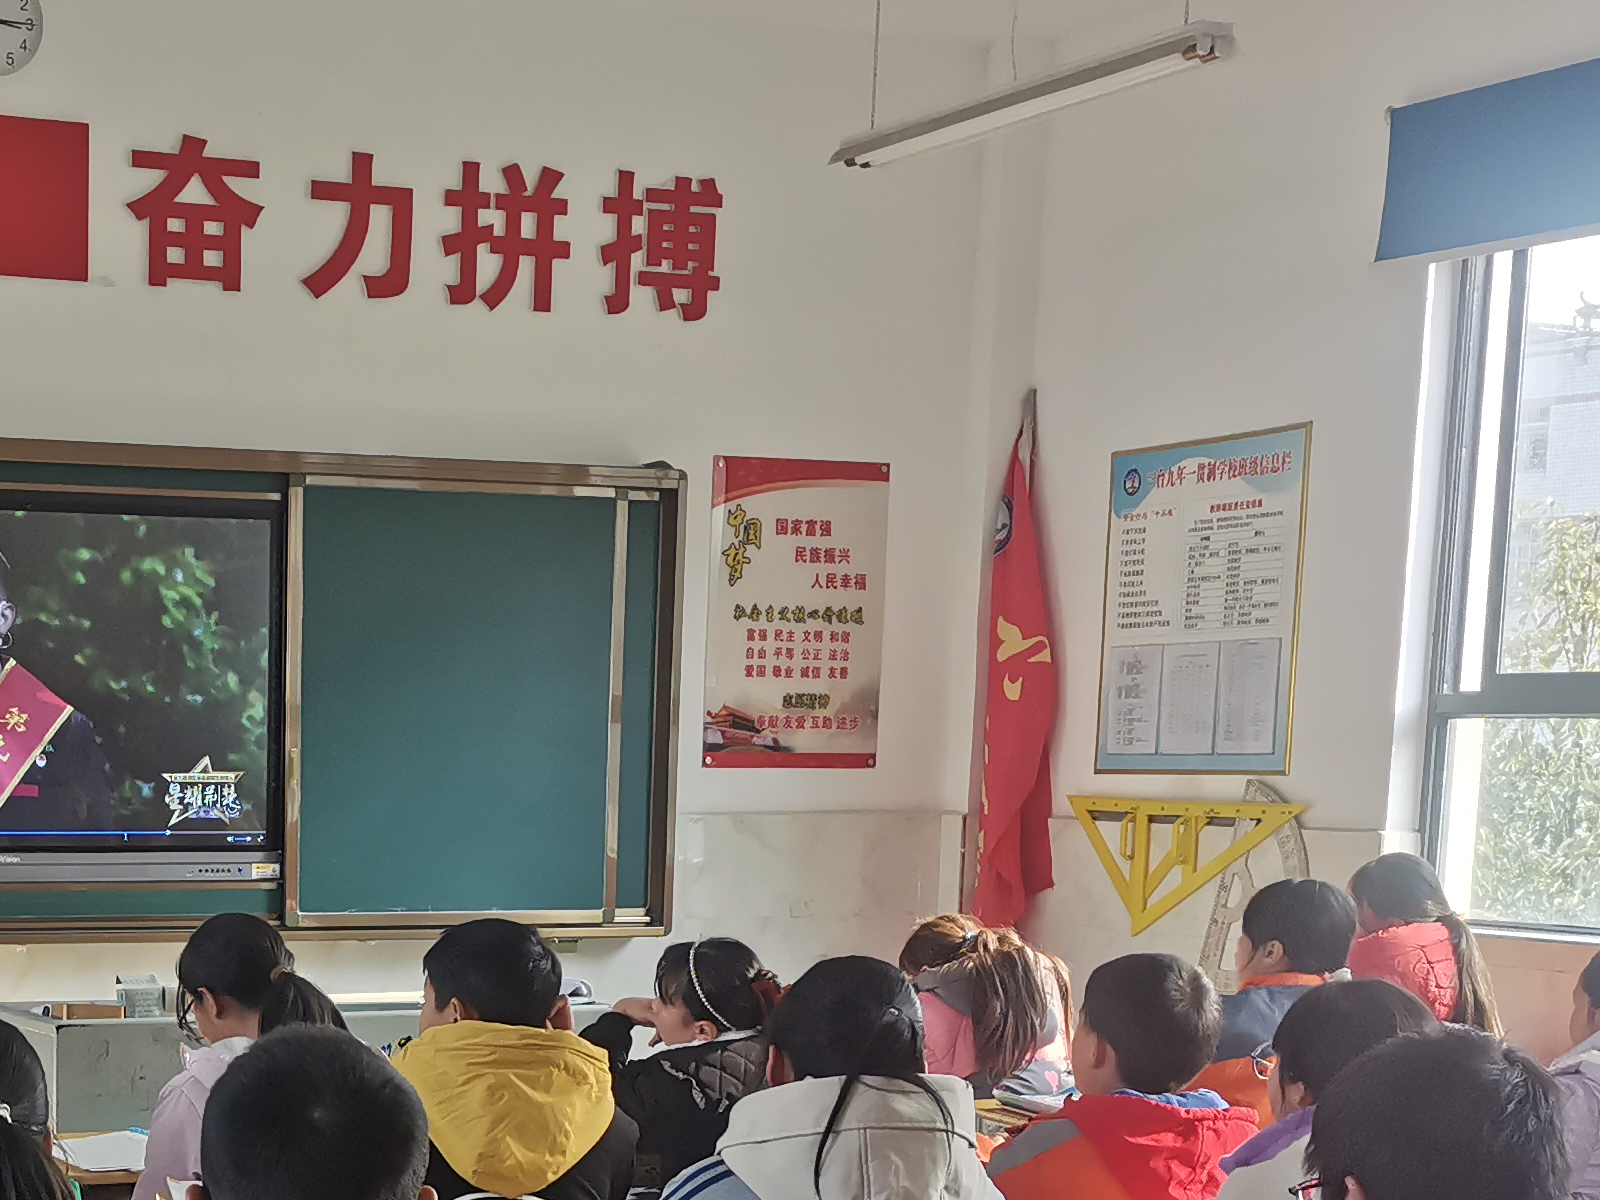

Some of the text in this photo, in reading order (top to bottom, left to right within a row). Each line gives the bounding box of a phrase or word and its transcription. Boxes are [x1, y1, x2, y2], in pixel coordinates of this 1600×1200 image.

[20, 0, 29, 11] 2
[25, 18, 34, 31] 3
[19, 39, 28, 52] 4
[5, 52, 15, 66] 5
[125, 134, 724, 323] 奋力拼搏
[775, 518, 832, 537] 国家富强
[722, 503, 762, 587] 中国梦
[794, 546, 851, 565] 民族振兴
[811, 573, 867, 591] 人民幸福
[746, 628, 850, 644] 富强 民主 文明 和谐
[745, 645, 850, 662] 自由 平等 公正 法治
[744, 664, 849, 680] 爱国 敬业 诚信 友善
[782, 715, 806, 729] 友爱
[810, 716, 833, 730] 互助
[836, 716, 860, 730] 进步
